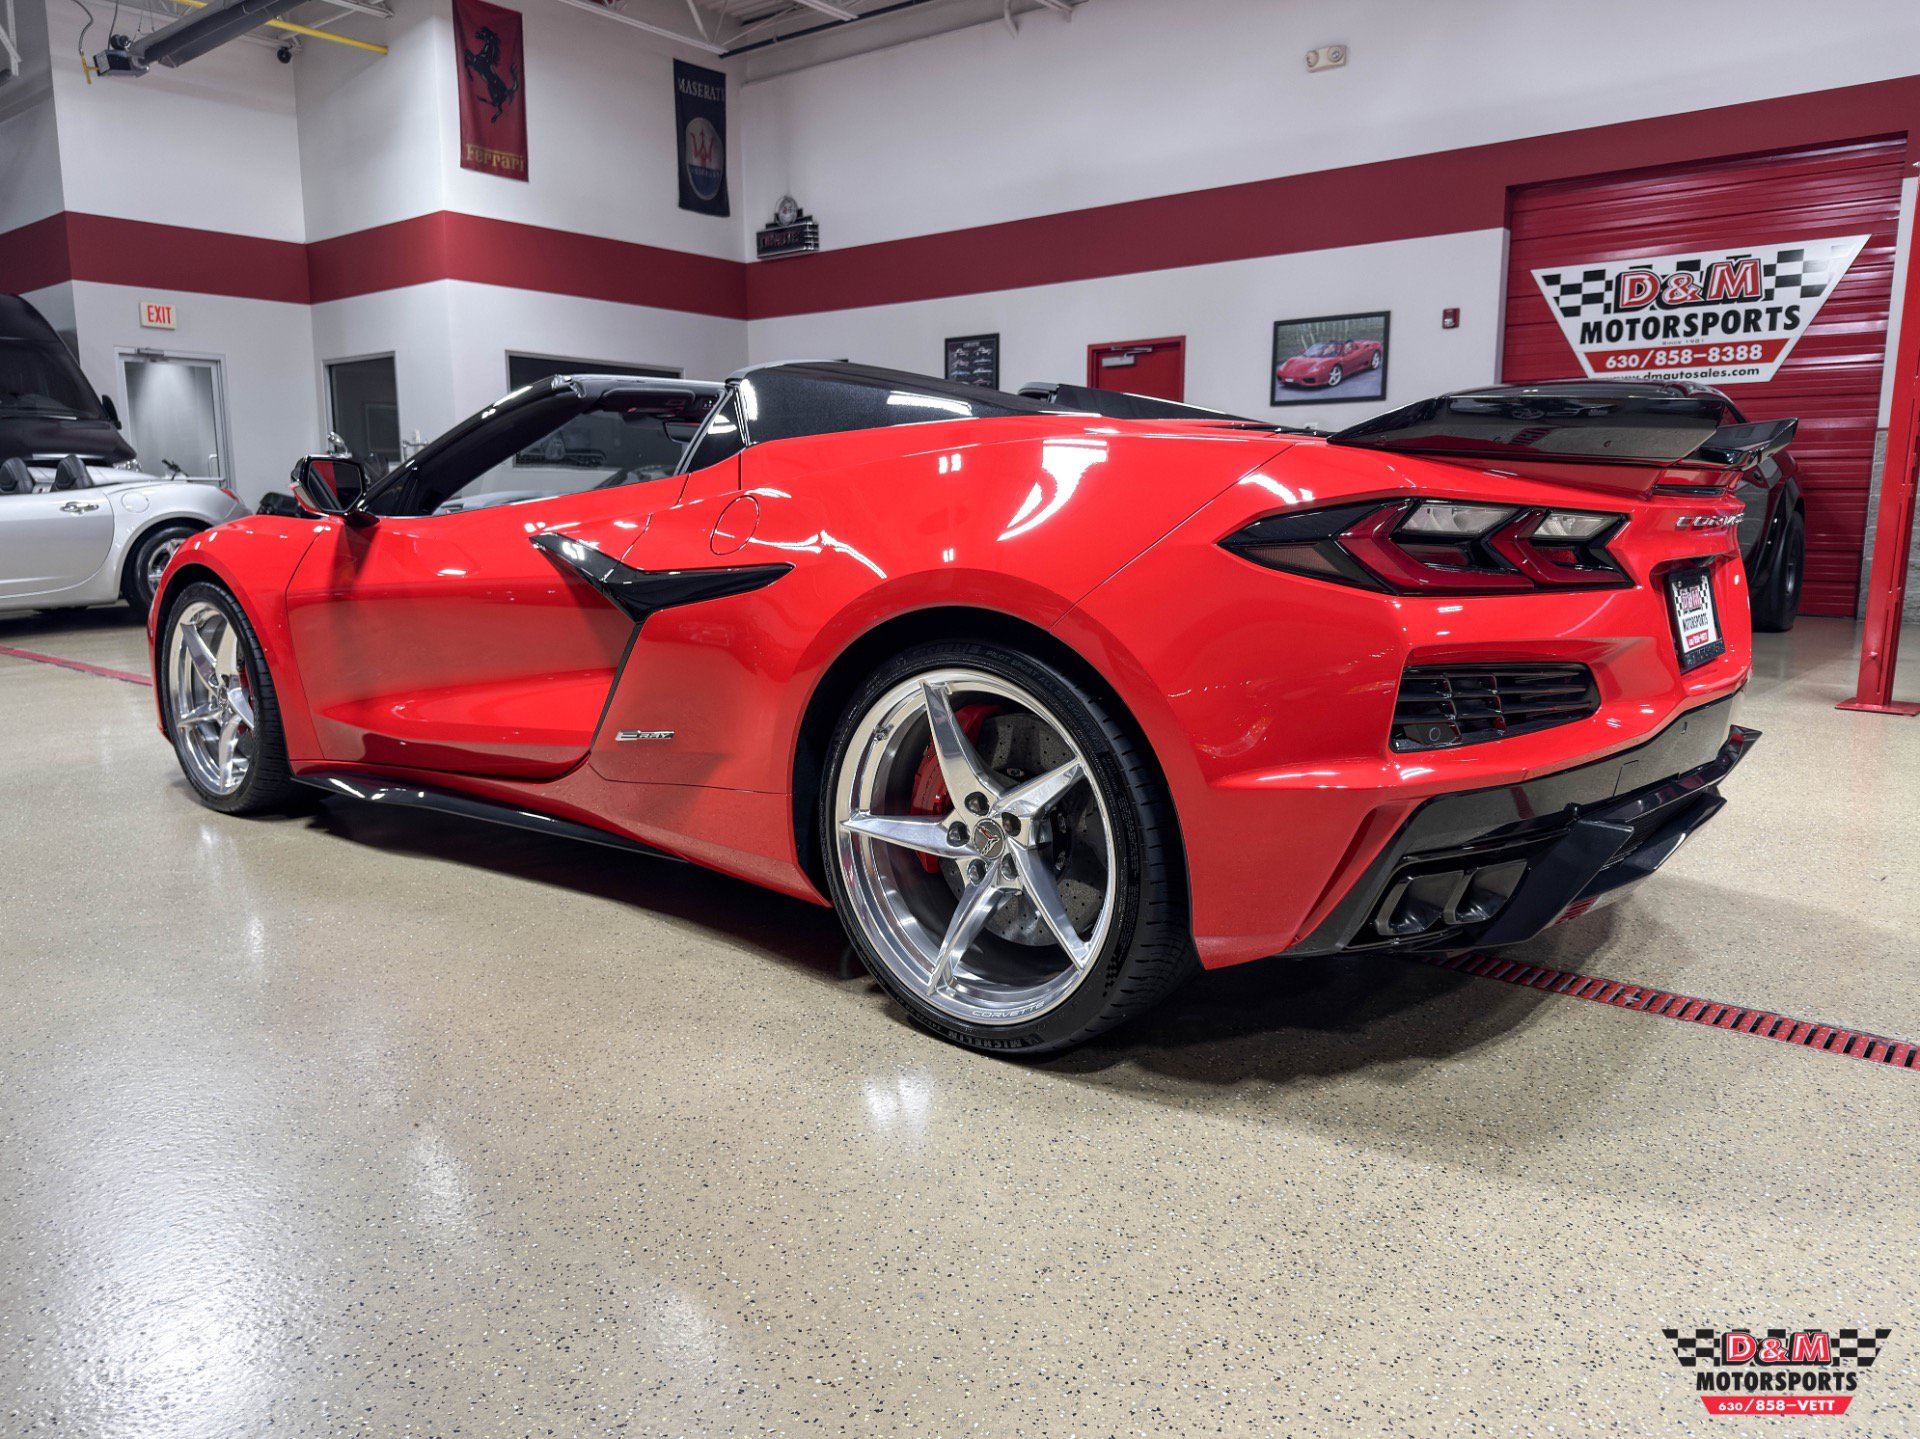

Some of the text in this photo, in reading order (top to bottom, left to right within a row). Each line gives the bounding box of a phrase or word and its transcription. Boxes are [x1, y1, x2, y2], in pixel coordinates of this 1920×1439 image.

[466, 143, 524, 171] Ferrari
[1615, 258, 1764, 312] D&M
[147, 304, 172, 325] EXIT
[1579, 305, 1801, 345] MOTORSPORTS
[1604, 344, 1763, 369] 630/858-8388
[972, 1001, 1045, 1018] CORVETTE
[948, 1030, 1023, 1049] MICHELIN
